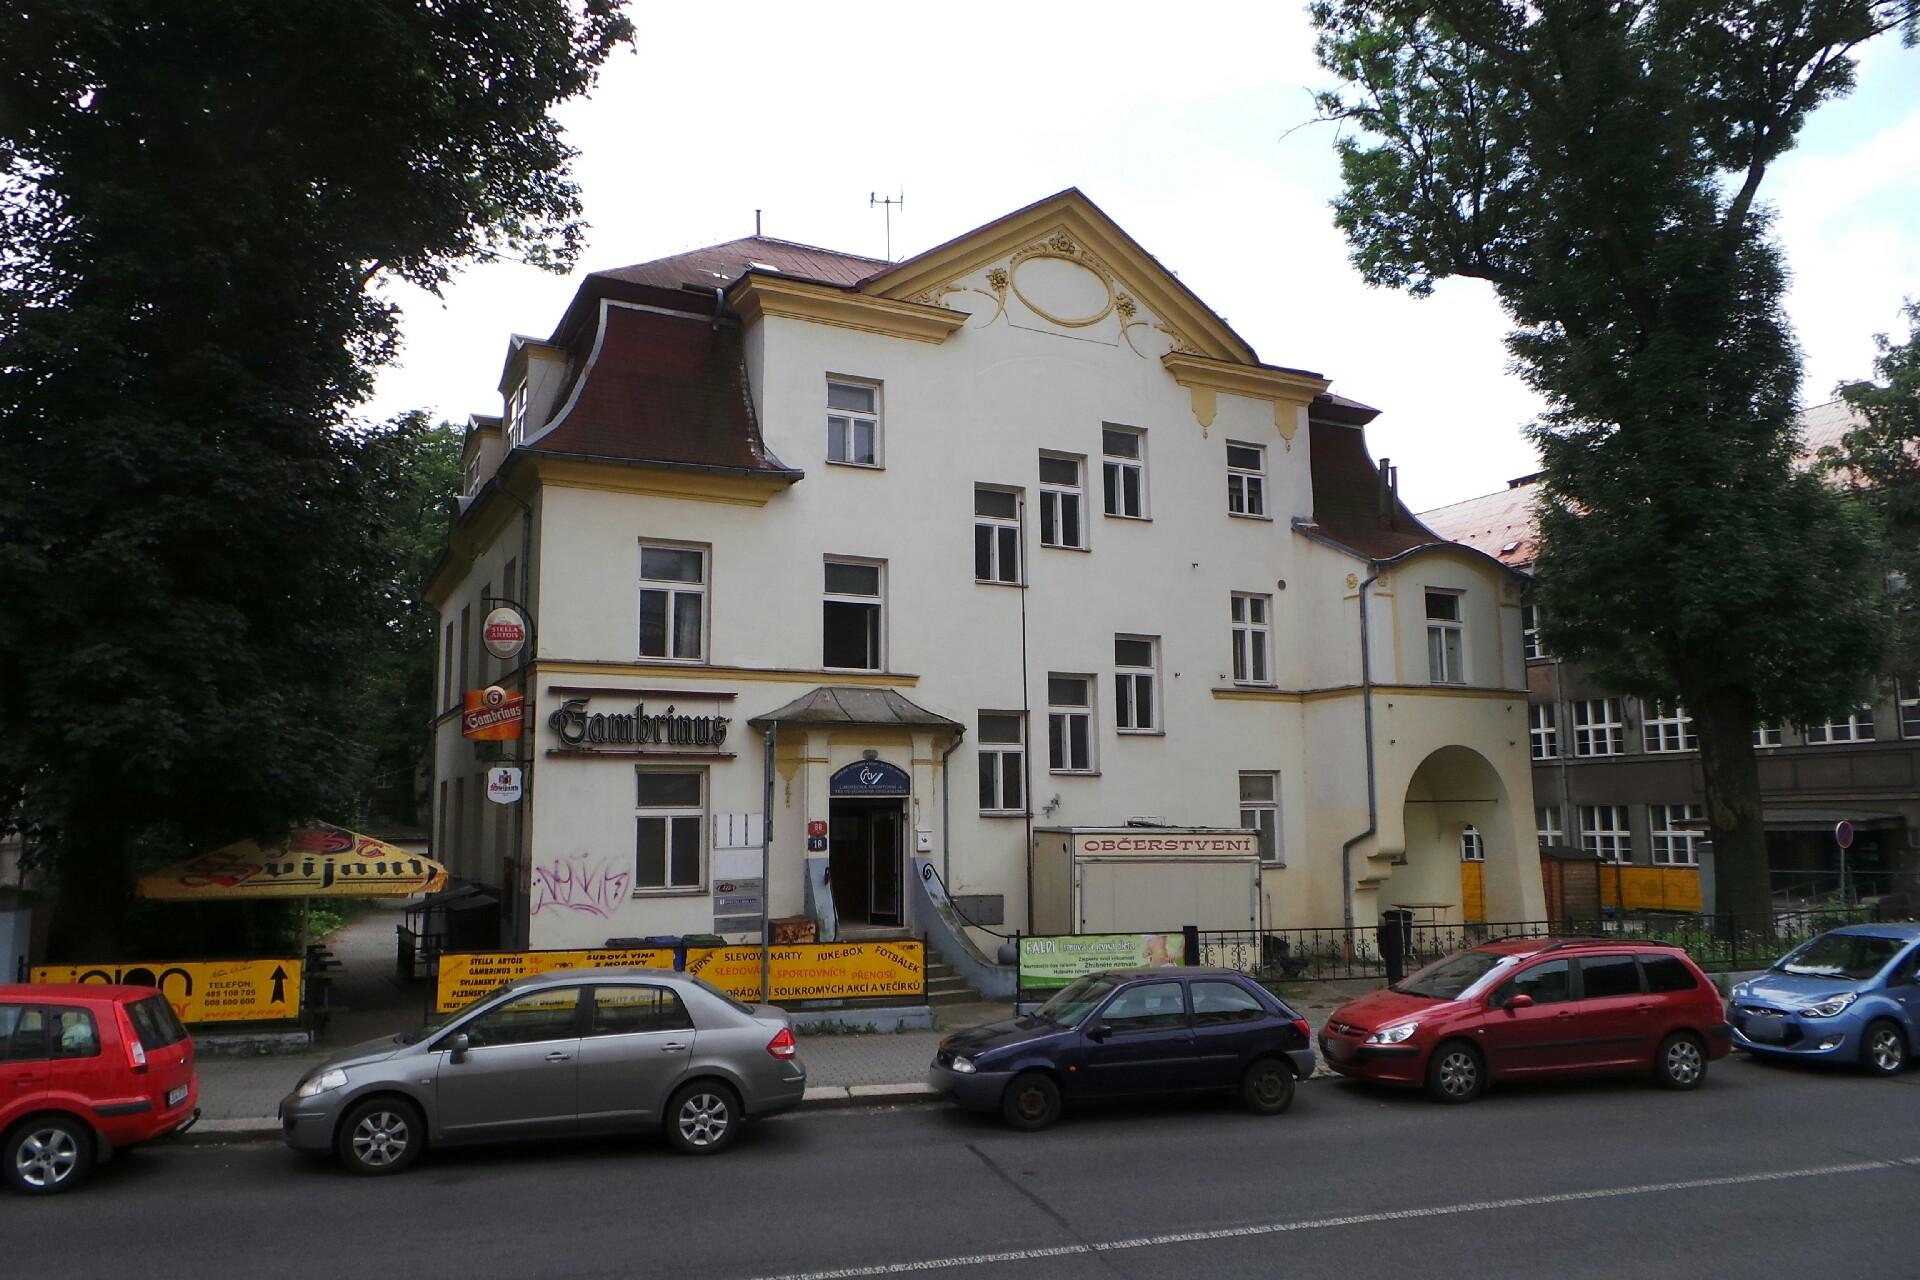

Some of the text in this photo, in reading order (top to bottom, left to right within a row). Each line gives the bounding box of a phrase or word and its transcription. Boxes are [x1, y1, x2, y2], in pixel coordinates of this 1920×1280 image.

[468, 705, 521, 728] Gambrinus
[549, 697, 732, 745] Gambrinus
[814, 839, 823, 848] 18
[1084, 837, 1251, 851] OBČERSTVENÍ
[498, 957, 523, 965] ARTOIS
[724, 952, 802, 961] SLEVOV KARTY
[817, 946, 863, 961] JUKE-BOX
[875, 946, 920, 973] FOTBÁLEK
[725, 980, 920, 997] OŘÁDÁÍ SOUKROMÝCH AKCÍ A VEČÍRKŮ
